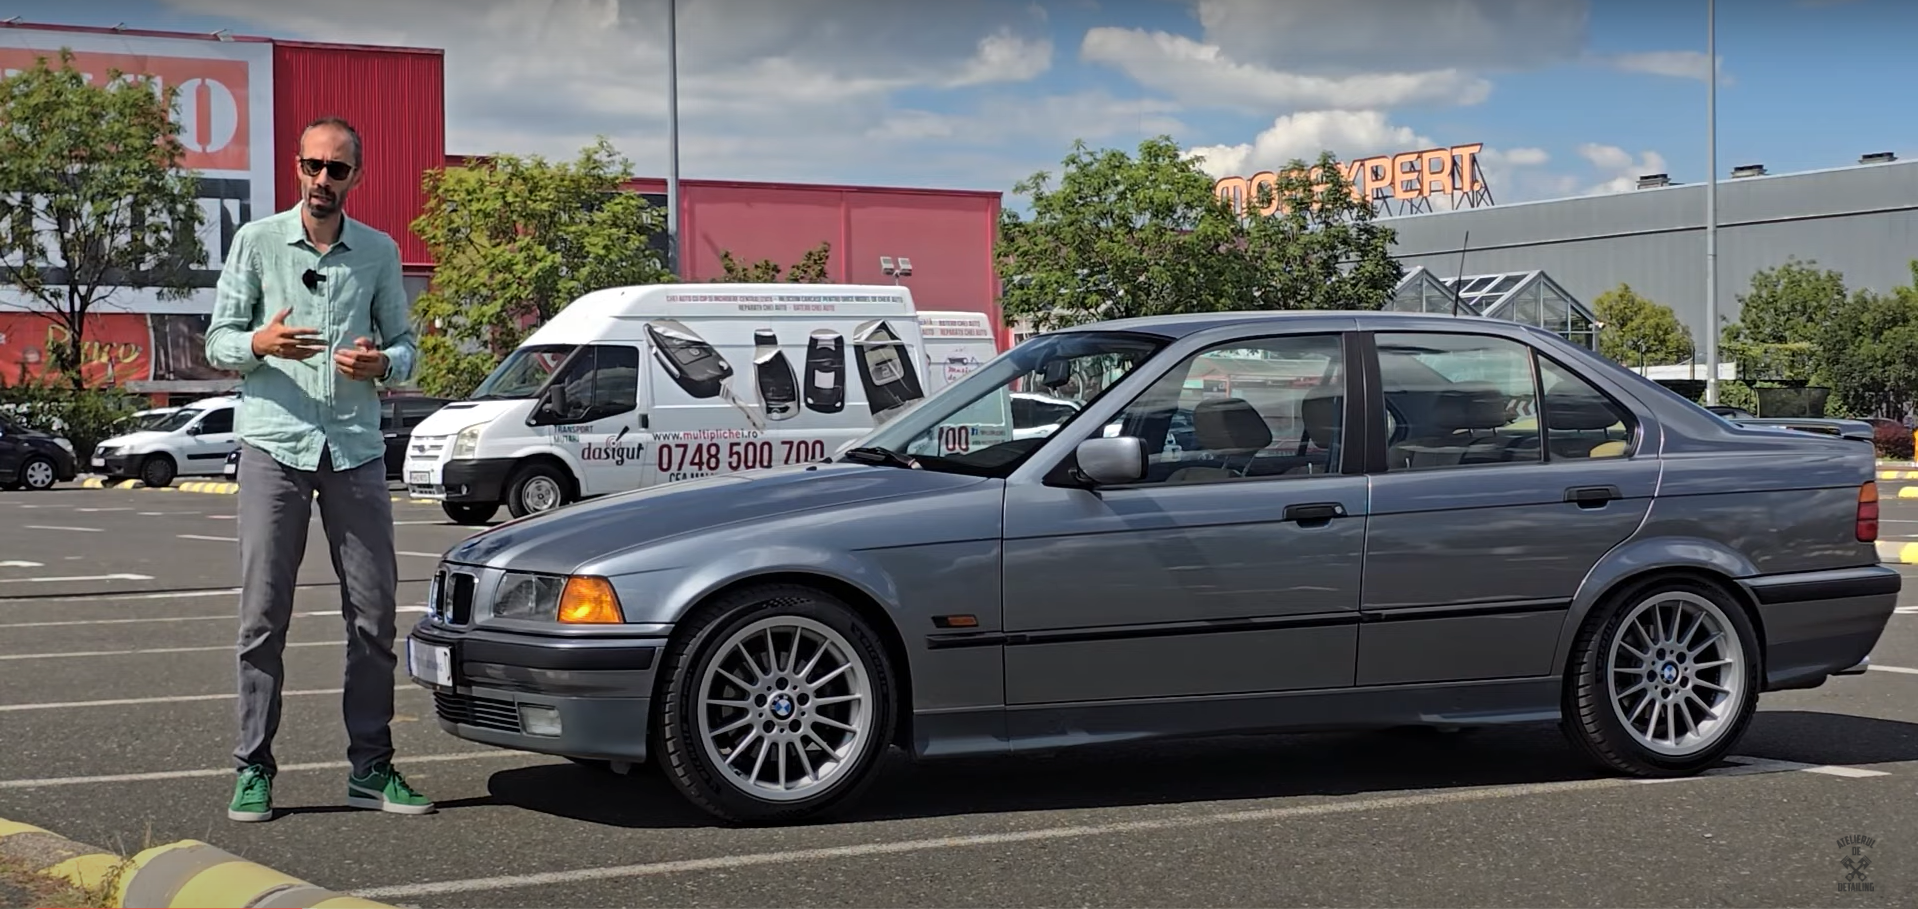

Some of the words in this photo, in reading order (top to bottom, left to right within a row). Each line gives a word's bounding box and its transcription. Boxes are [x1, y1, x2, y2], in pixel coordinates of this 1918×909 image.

[554, 425, 593, 434] TRANSPORT
[653, 430, 758, 442] www.multiplichei.ro
[658, 442, 720, 473] 0748
[728, 441, 773, 471] 500
